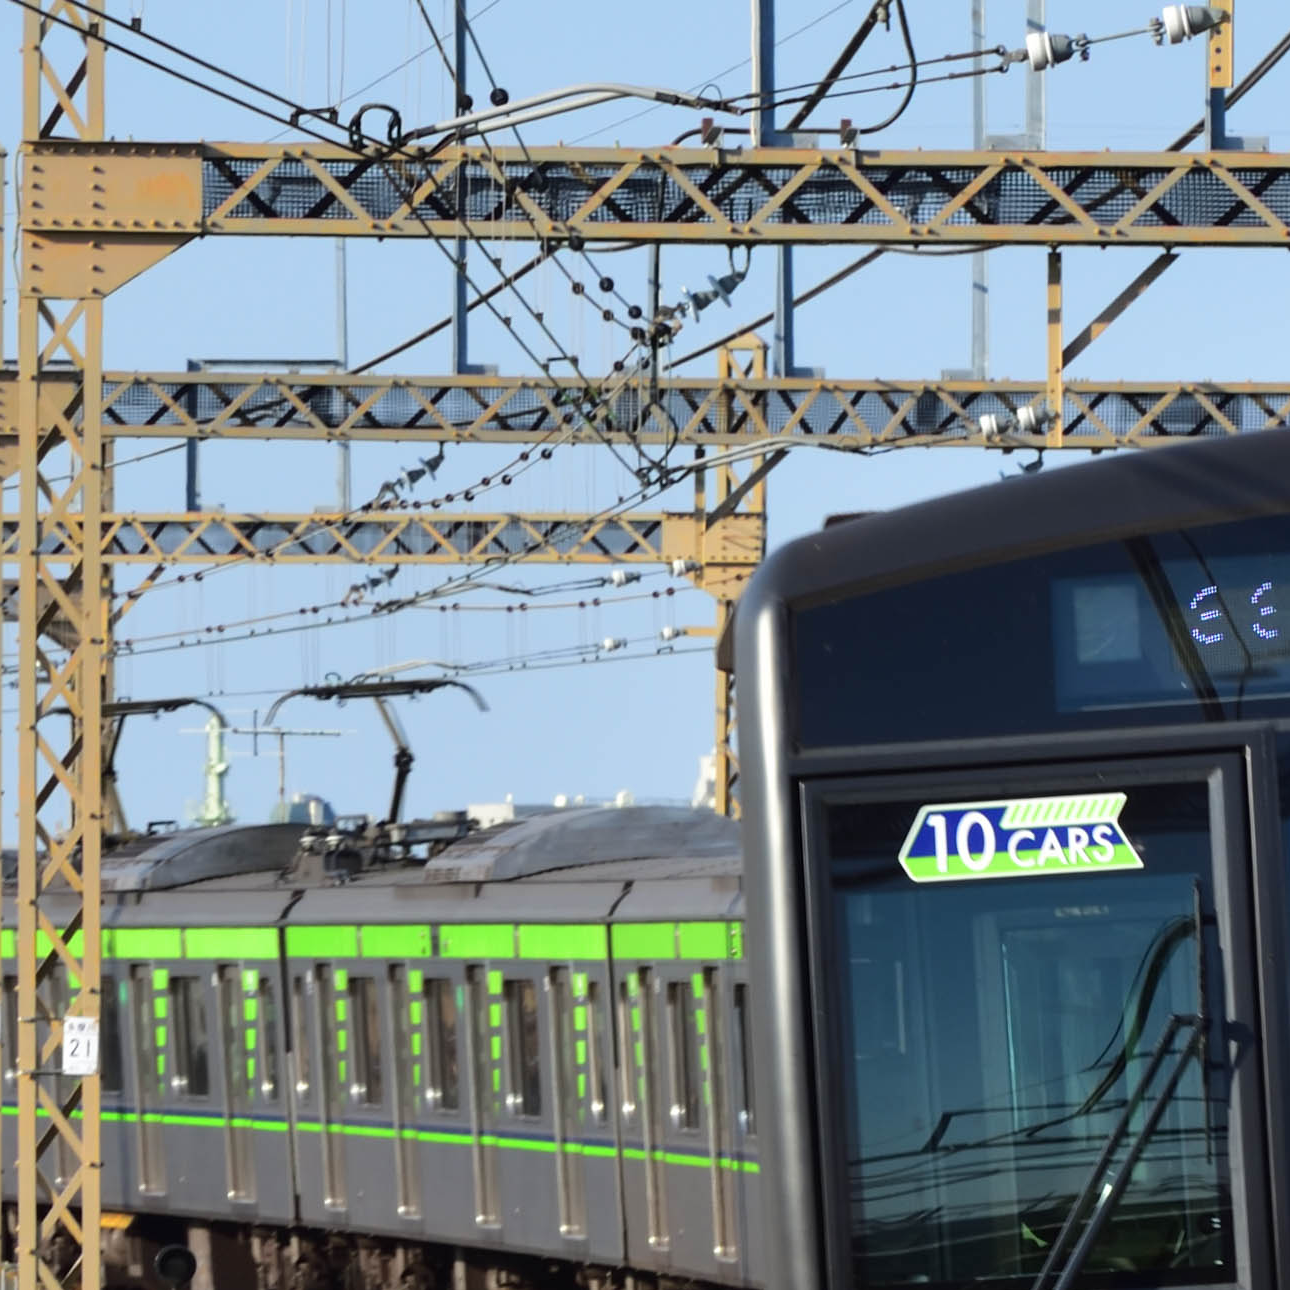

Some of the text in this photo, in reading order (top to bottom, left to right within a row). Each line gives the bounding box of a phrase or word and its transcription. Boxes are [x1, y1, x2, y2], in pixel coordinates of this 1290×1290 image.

[926, 810, 1116, 873] 10 CARS
[69, 1038, 91, 1057] 21
